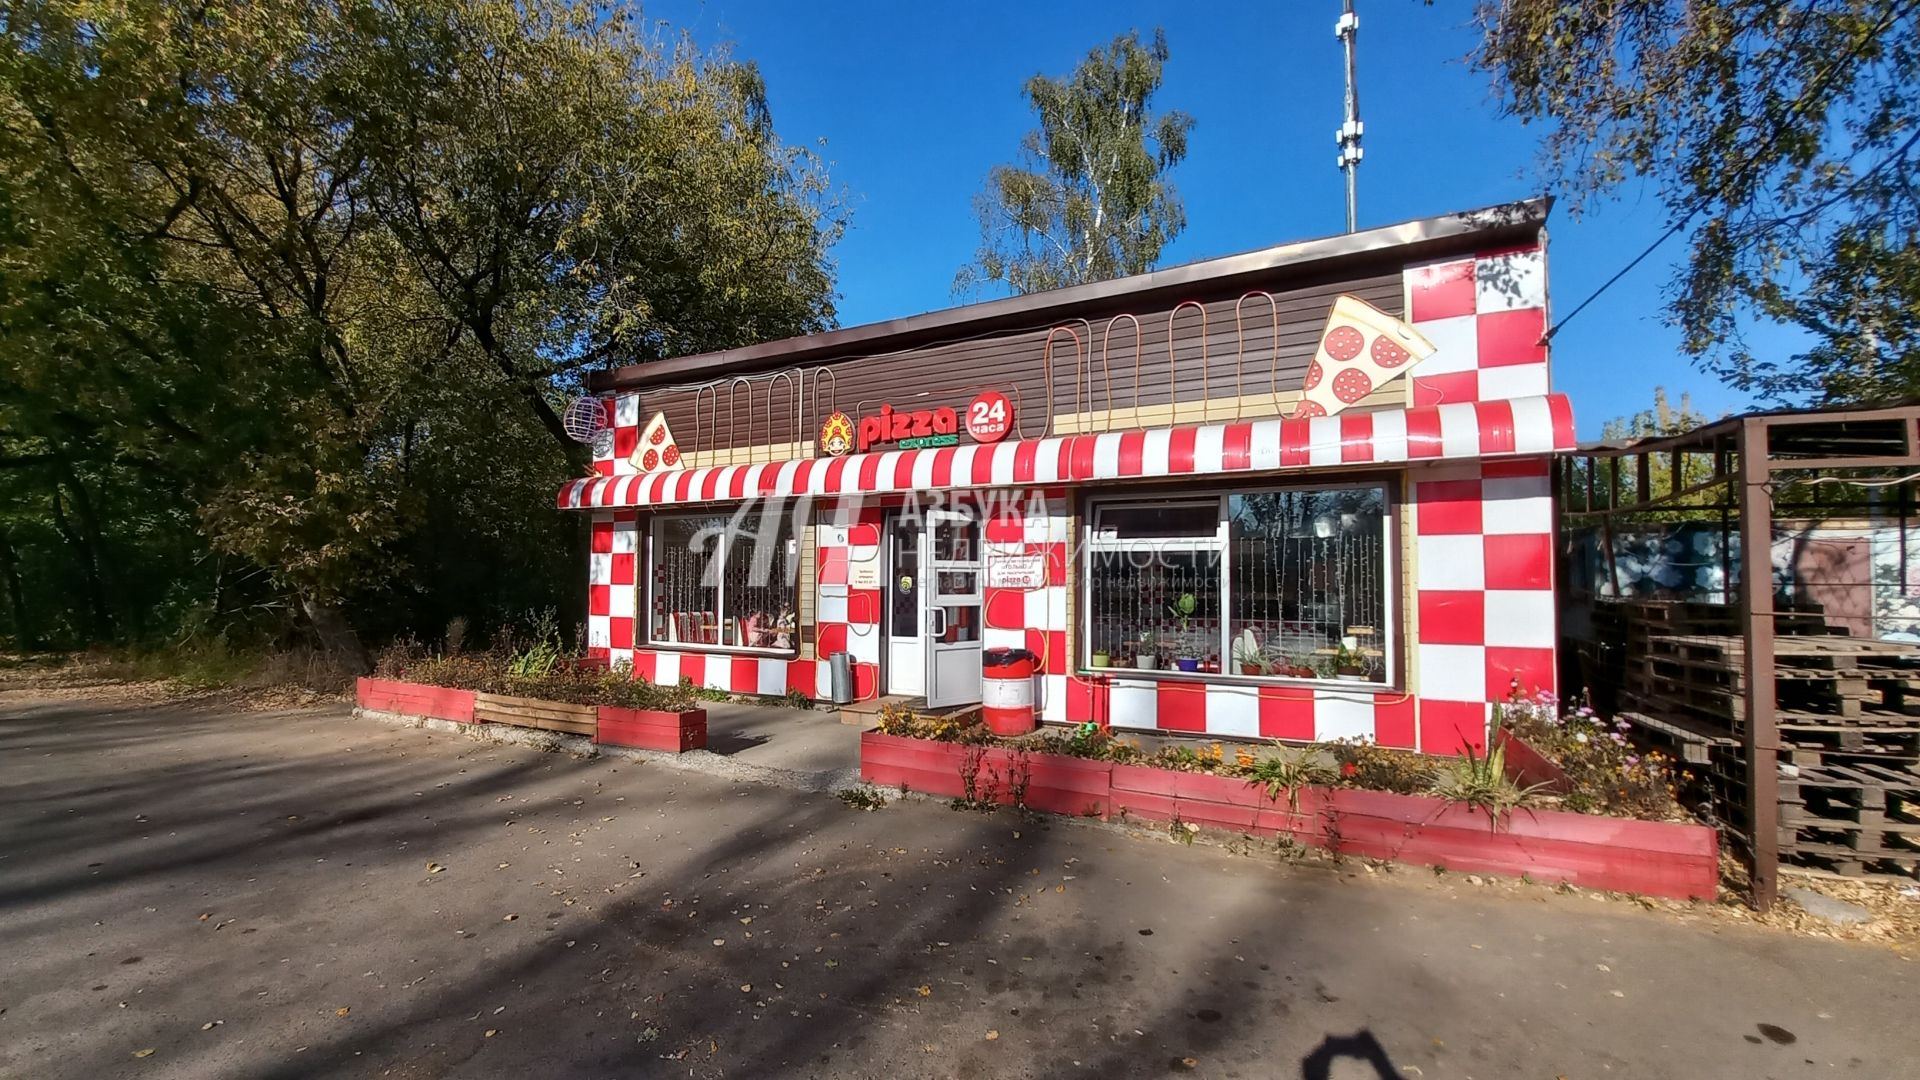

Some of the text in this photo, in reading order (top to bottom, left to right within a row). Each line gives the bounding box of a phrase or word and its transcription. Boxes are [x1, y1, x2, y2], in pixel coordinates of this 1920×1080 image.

[972, 400, 1006, 424] 24
[859, 403, 957, 450] pizza
[972, 423, 1005, 434] часа
